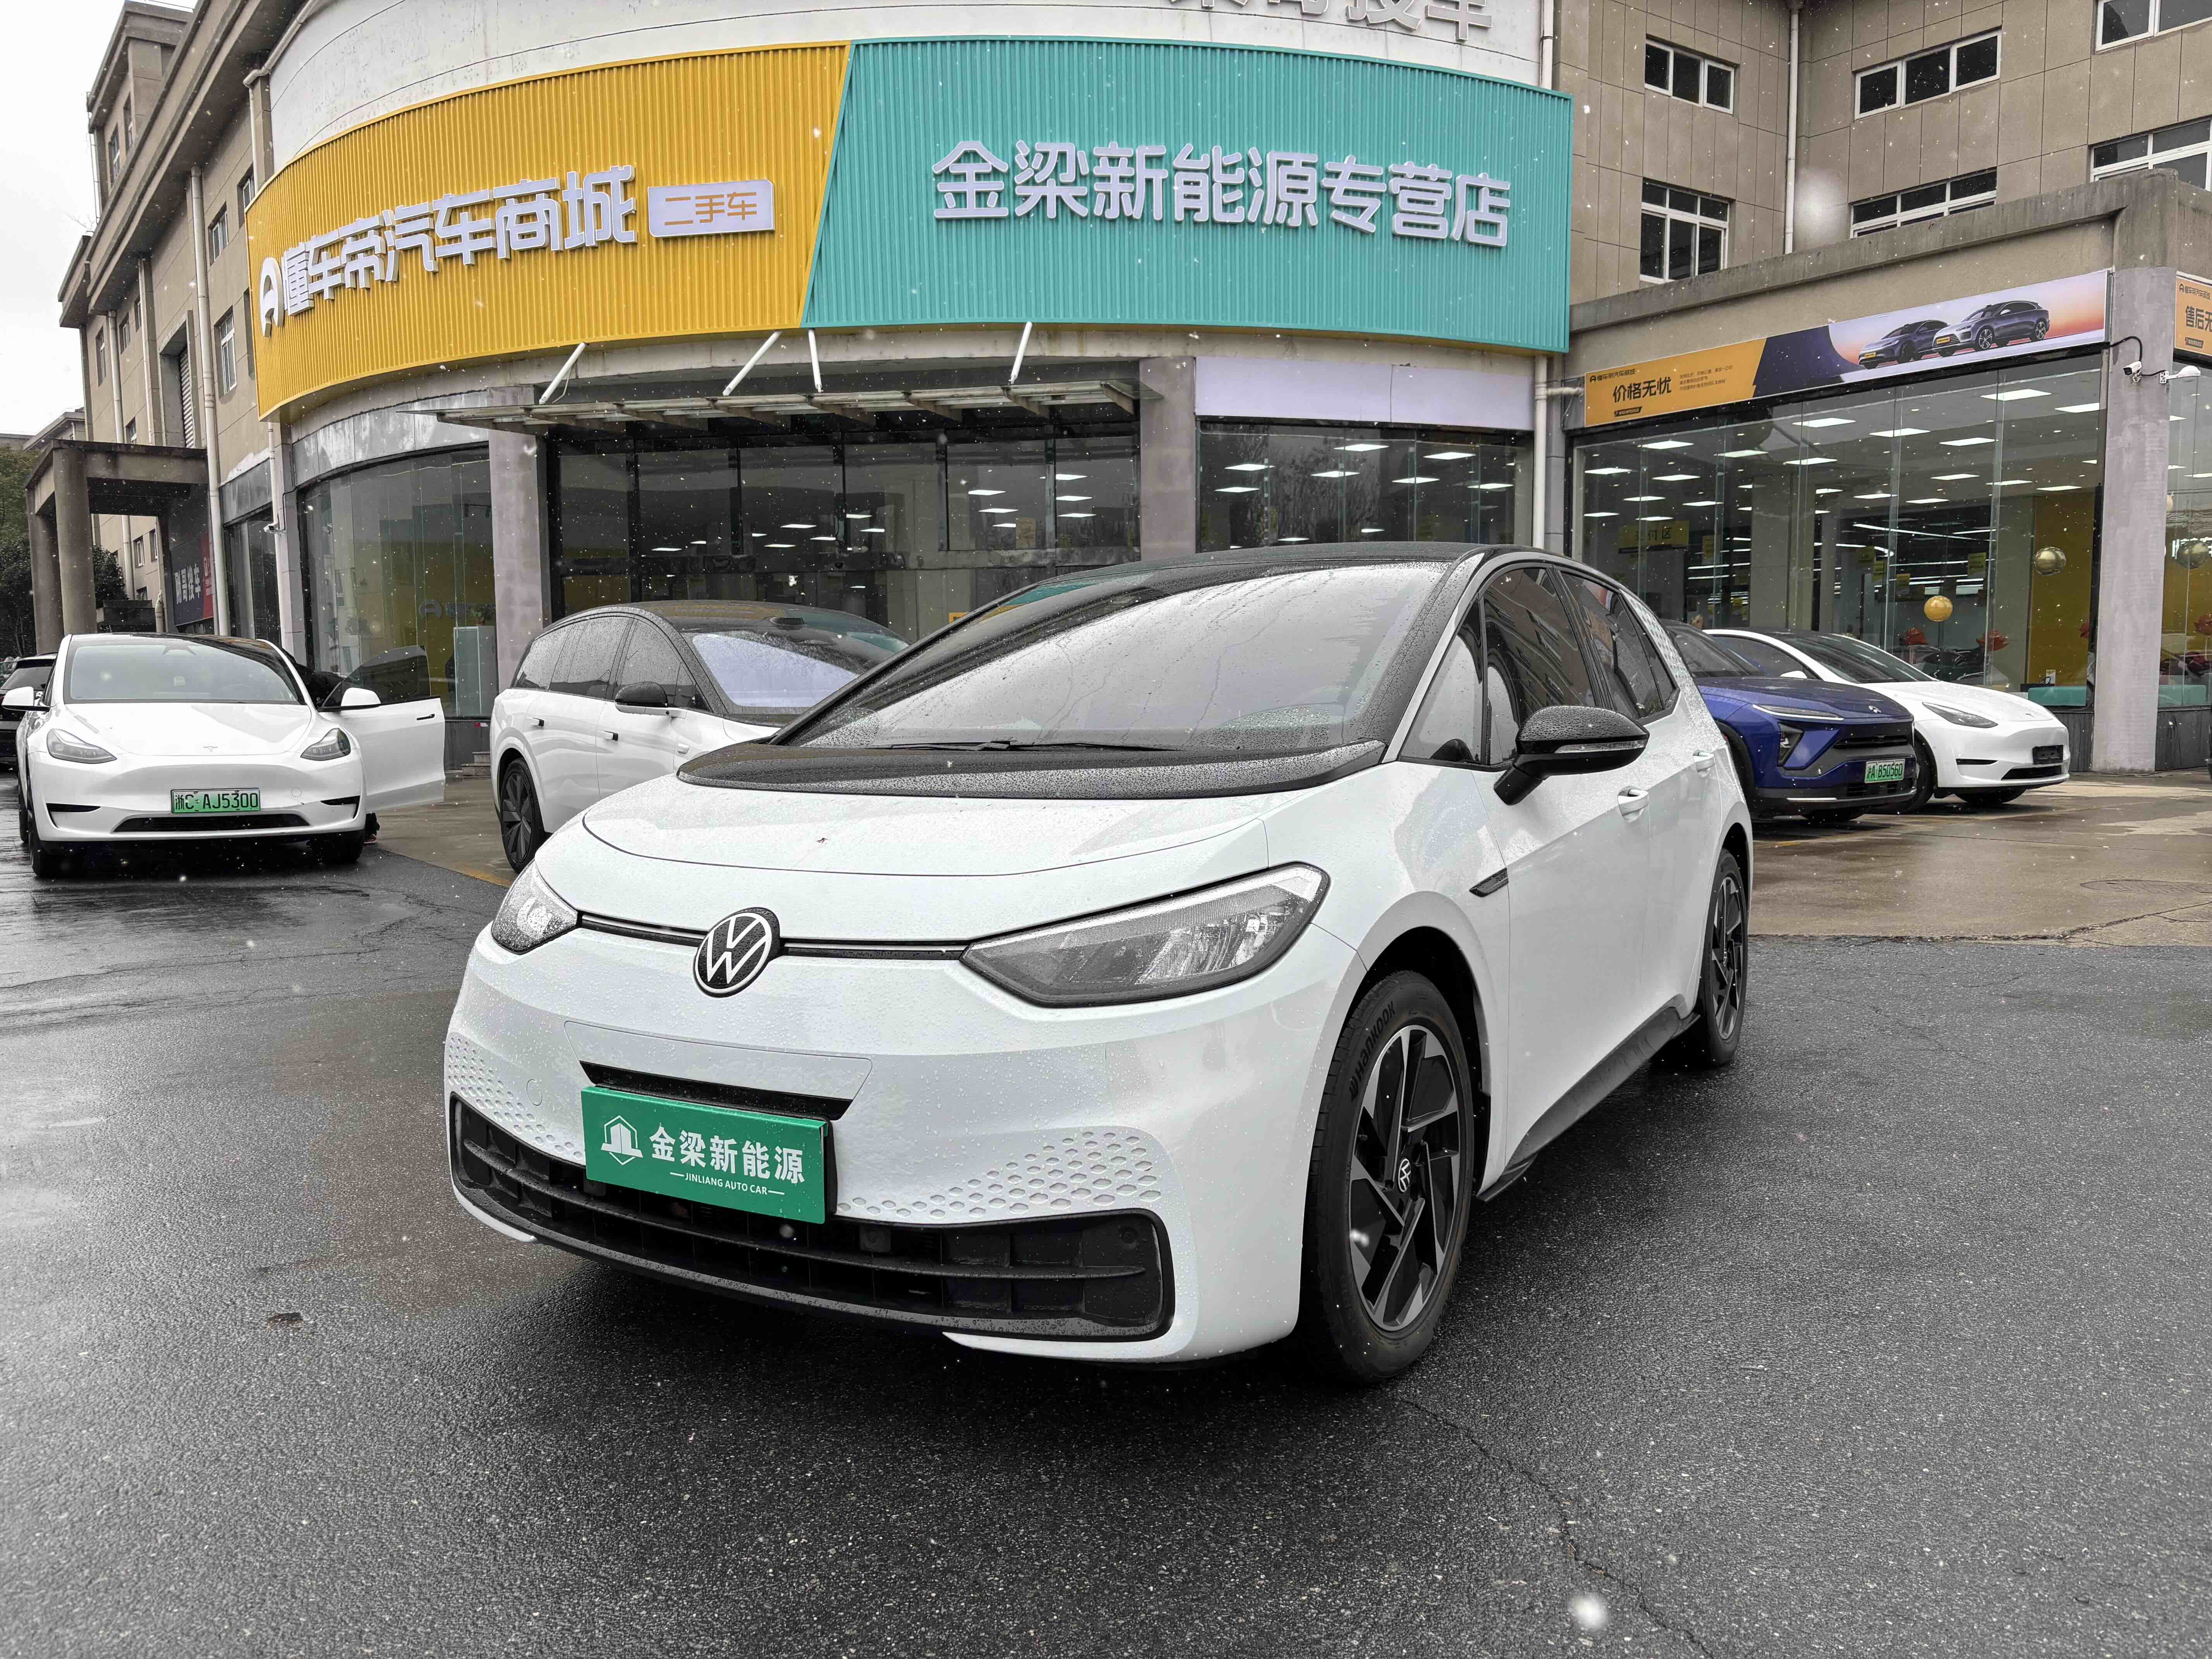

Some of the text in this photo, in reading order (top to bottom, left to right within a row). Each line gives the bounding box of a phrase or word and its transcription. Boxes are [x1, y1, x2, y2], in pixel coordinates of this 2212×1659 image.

[664, 191, 757, 225] 二手车
[933, 140, 1511, 248] 金梁新能源专营店
[282, 165, 636, 316] 懂车帝汽车商城
[1613, 376, 1672, 403] 价格无忧
[649, 1126, 805, 1184] 金梁新能源
[685, 1173, 768, 1195] JINLIANG AUTO CAR
